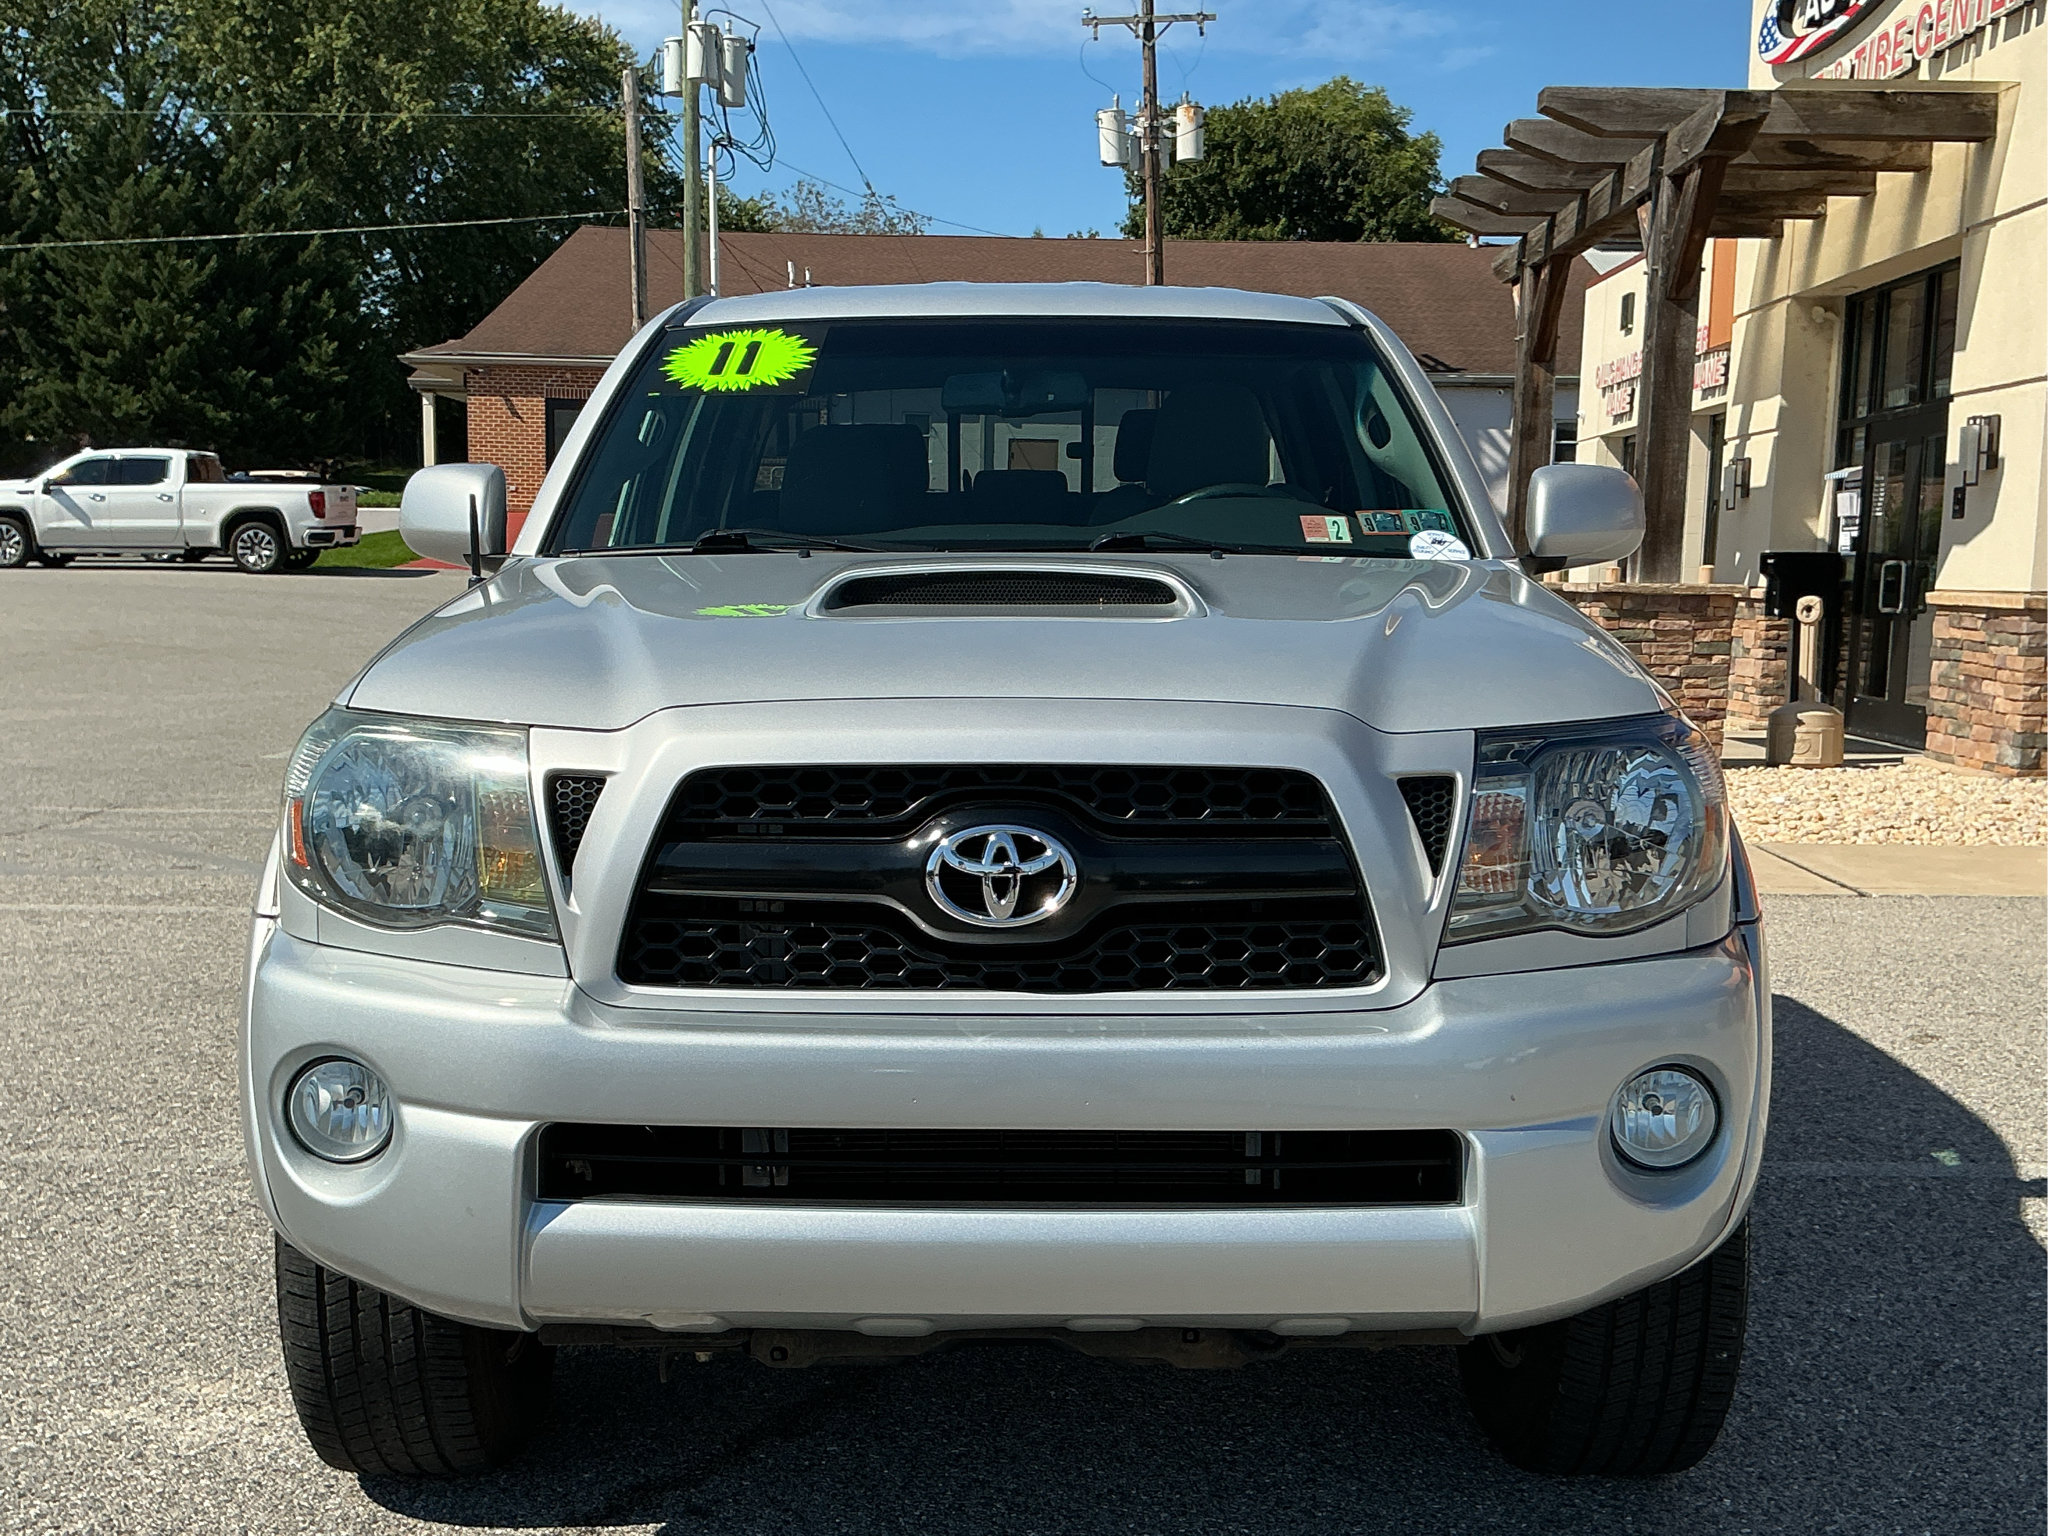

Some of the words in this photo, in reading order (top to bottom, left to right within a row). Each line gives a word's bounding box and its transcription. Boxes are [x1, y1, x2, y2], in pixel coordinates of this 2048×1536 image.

[1854, 19, 1909, 79] TIRE
[1914, 0, 2015, 58] CEN
[708, 340, 765, 377] 11
[1693, 356, 1725, 390] LANE
[1606, 388, 1629, 417] LANE
[1332, 520, 1344, 541] 2
